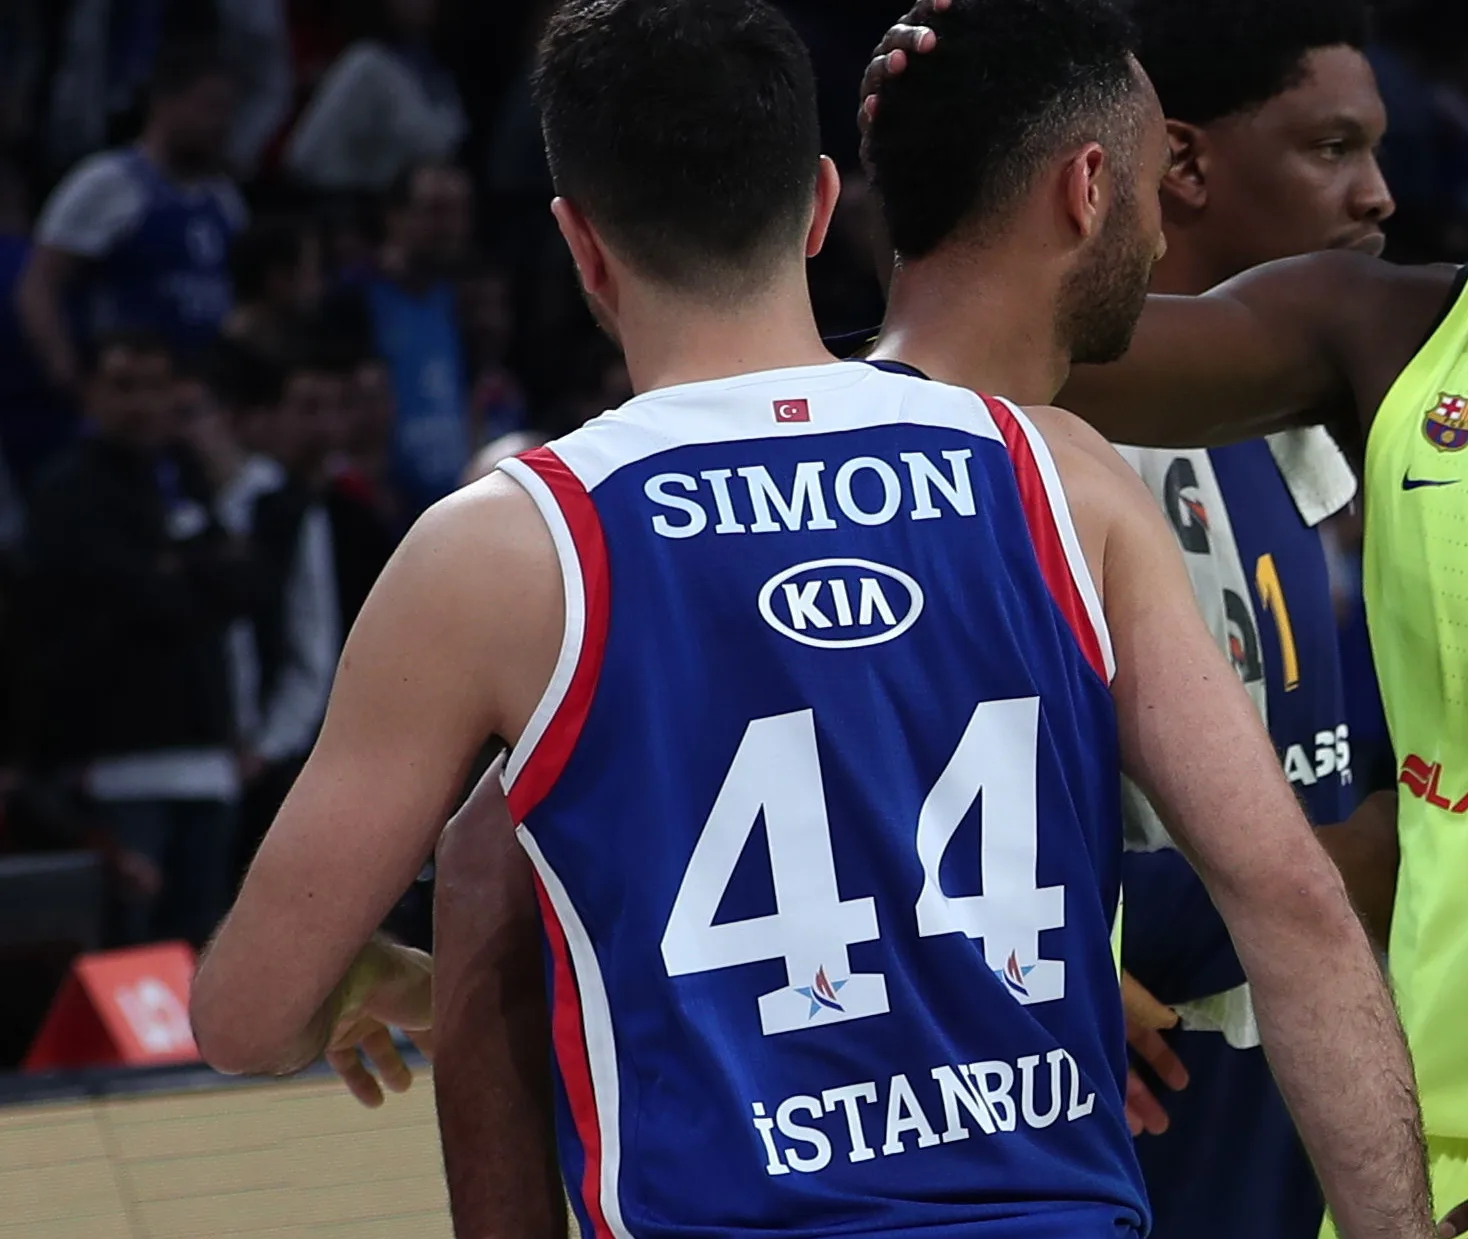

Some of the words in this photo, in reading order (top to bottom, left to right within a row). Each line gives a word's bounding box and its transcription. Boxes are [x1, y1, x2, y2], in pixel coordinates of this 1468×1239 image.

[644, 449, 977, 539] SIMON
[782, 577, 897, 630] KIA
[660, 695, 1066, 1036] 44
